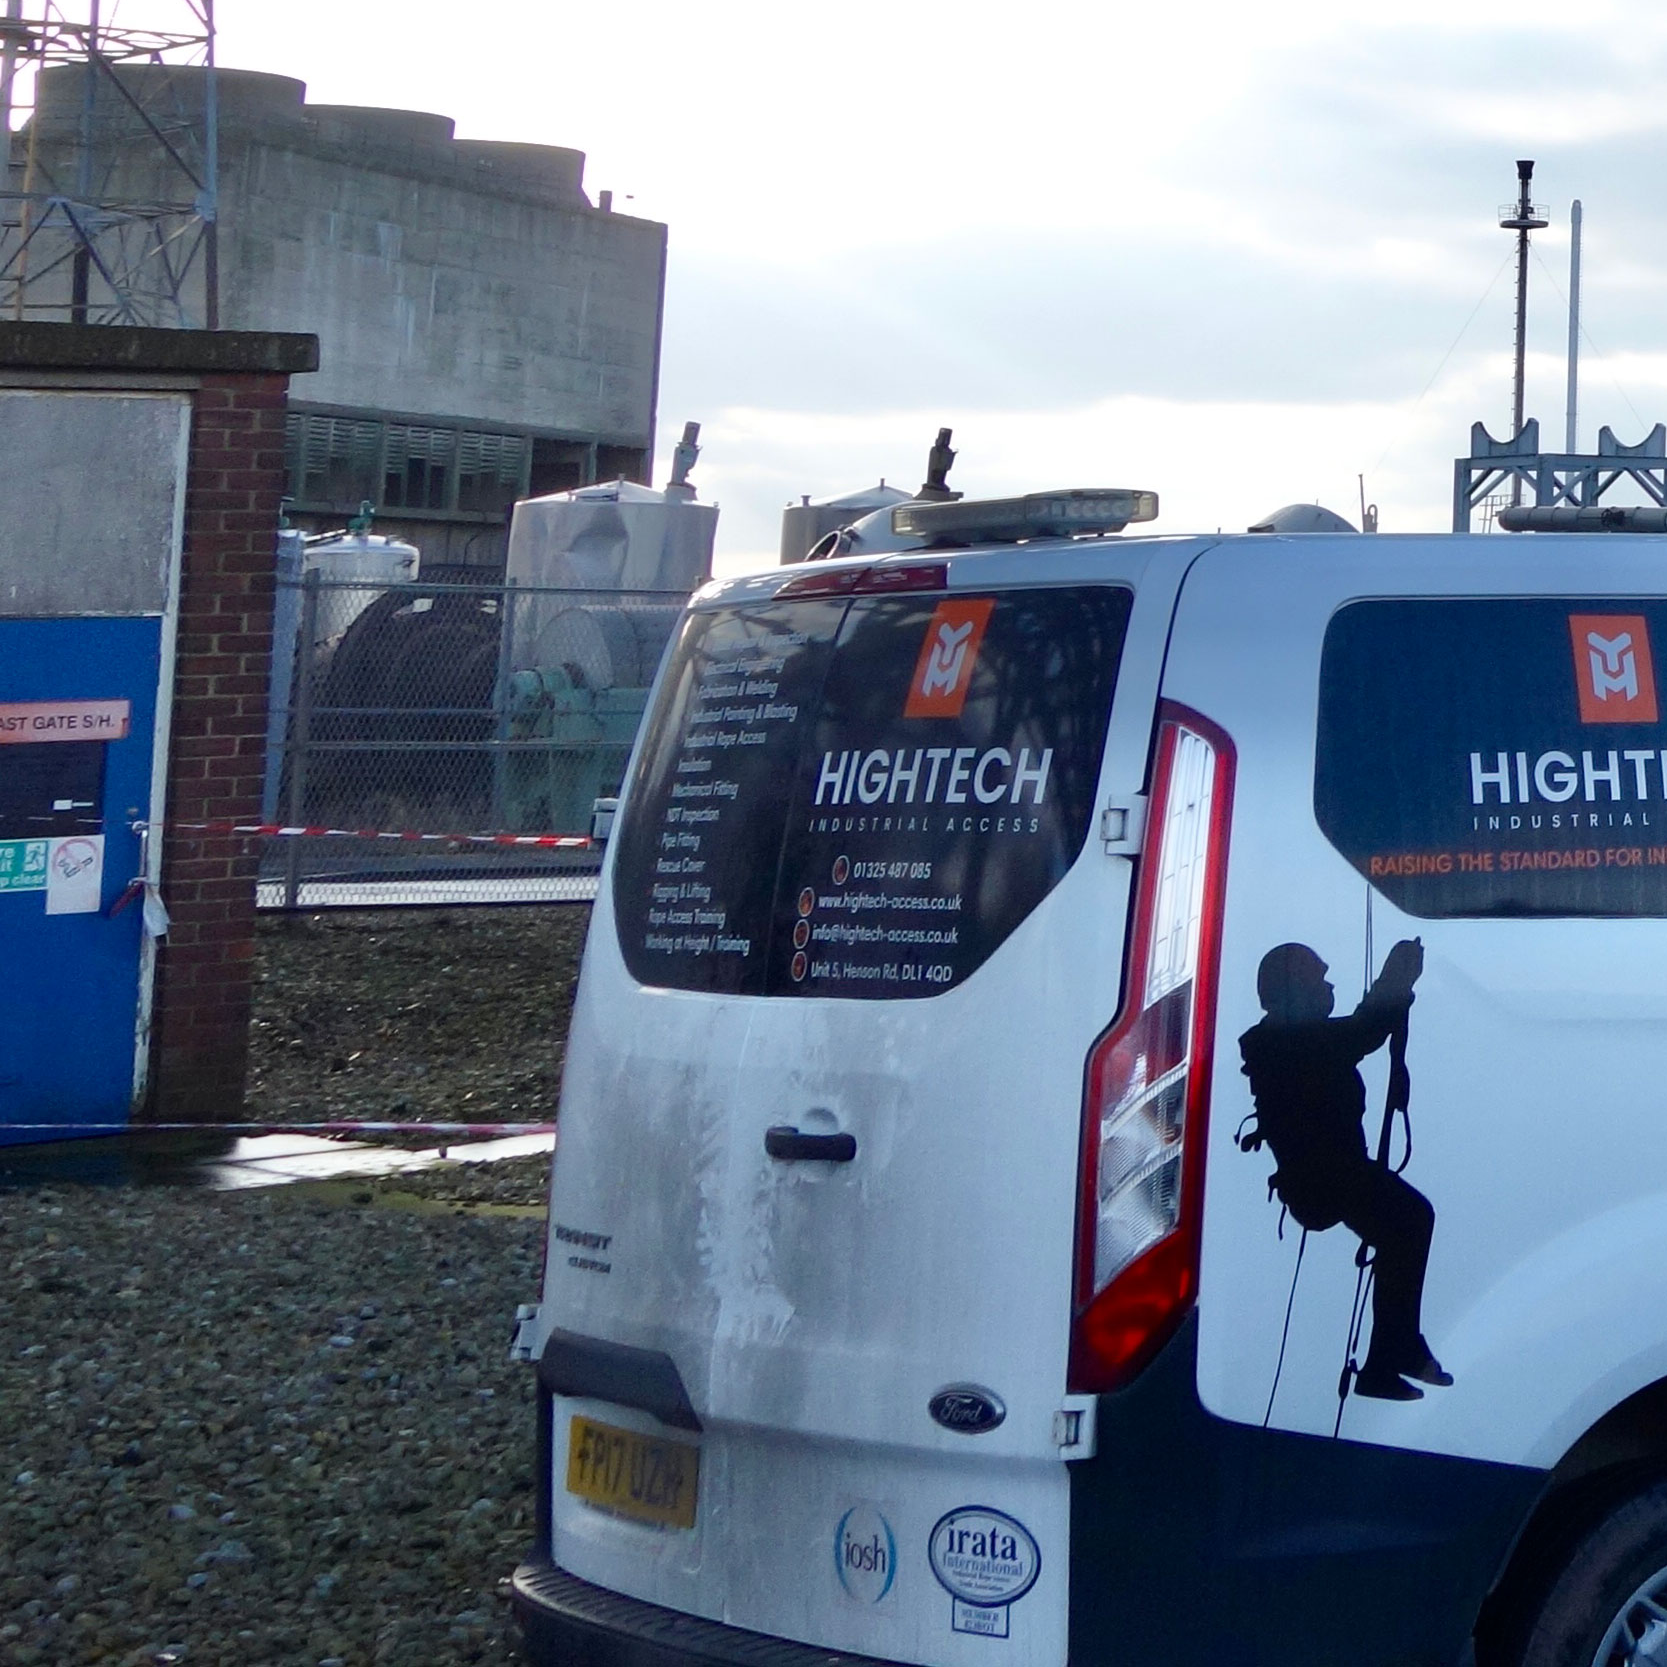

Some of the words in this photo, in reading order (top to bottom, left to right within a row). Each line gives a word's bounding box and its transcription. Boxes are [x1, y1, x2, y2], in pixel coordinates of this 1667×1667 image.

[33, 715, 78, 730] GATE
[814, 746, 1054, 806] HIGHTECH
[809, 817, 929, 833] INDUSTRIAL
[947, 818, 1039, 833] ACCESS
[1473, 812, 1651, 830] INDUSTRIAL
[853, 862, 886, 879] 01325
[887, 862, 908, 879] 487
[910, 862, 932, 879] 085
[1370, 853, 1453, 876] RAISING
[1458, 852, 1494, 873] THE
[1499, 850, 1601, 871] STANDARD
[1605, 847, 1643, 867] FOR
[818, 892, 963, 913] www.hightech-access.co.uk
[812, 924, 959, 946] info@hightech-access.co.uk
[811, 961, 829, 978] Unit
[843, 962, 881, 979] Henson
[902, 964, 922, 980] DL1
[926, 965, 952, 981] 4QD
[939, 1397, 983, 1422] Ford
[947, 1516, 1017, 1562] irata
[844, 1532, 886, 1573] iosh
[943, 1553, 1024, 1578] International
